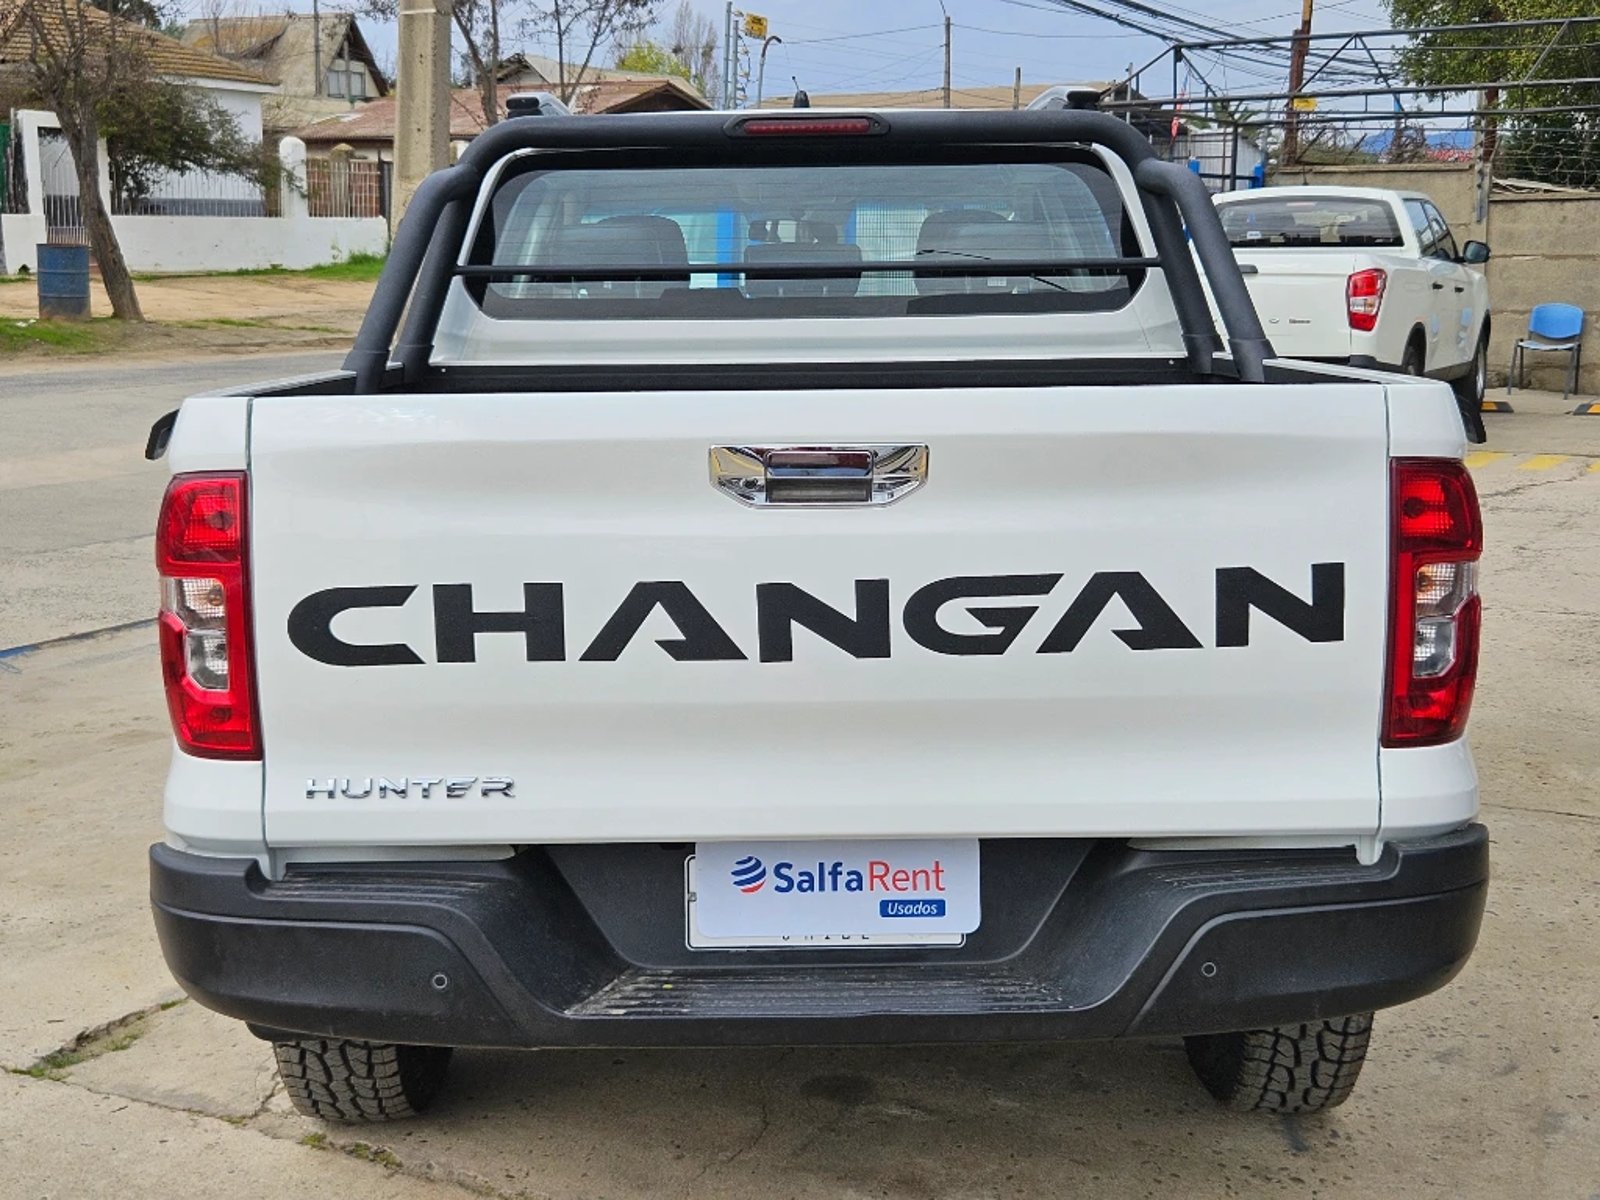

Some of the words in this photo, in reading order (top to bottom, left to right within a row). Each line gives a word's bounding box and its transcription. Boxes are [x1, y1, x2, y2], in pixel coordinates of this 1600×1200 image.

[287, 562, 1345, 666] CHANGAN
[305, 776, 516, 799] HUNTER
[773, 860, 946, 893] SalfaRent
[887, 901, 938, 915] Usados
